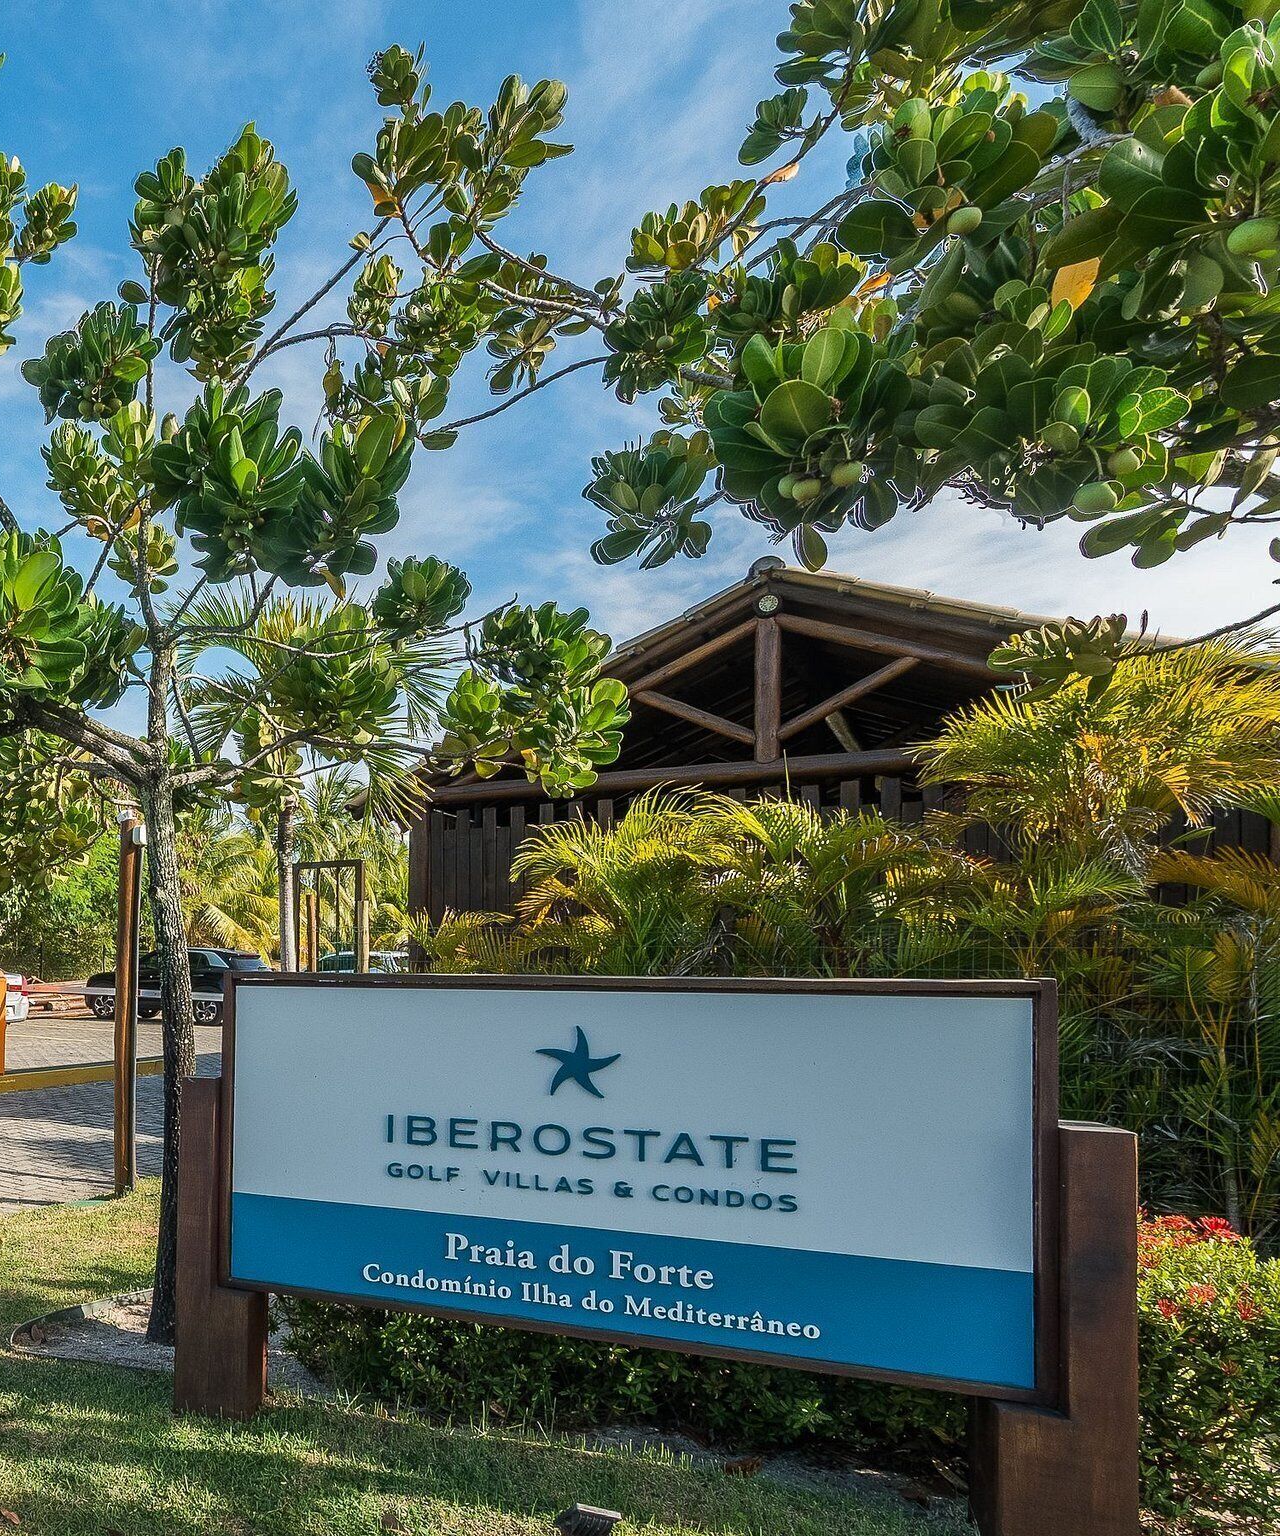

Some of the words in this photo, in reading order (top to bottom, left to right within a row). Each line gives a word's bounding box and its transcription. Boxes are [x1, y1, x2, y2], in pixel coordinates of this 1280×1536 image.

[386, 1113, 798, 1174] IBEROSTATE
[386, 1162, 460, 1183] GOLF
[482, 1169, 595, 1195] VILLAS
[613, 1181, 634, 1199] &
[652, 1184, 798, 1213] CONDOS
[444, 1232, 538, 1270] Praia
[548, 1244, 595, 1276] do
[608, 1249, 715, 1290] Forte
[362, 1263, 512, 1299] Condomínio
[521, 1282, 573, 1308] Ilha
[581, 1290, 615, 1313] do
[623, 1295, 821, 1340] Mediterrâneo
